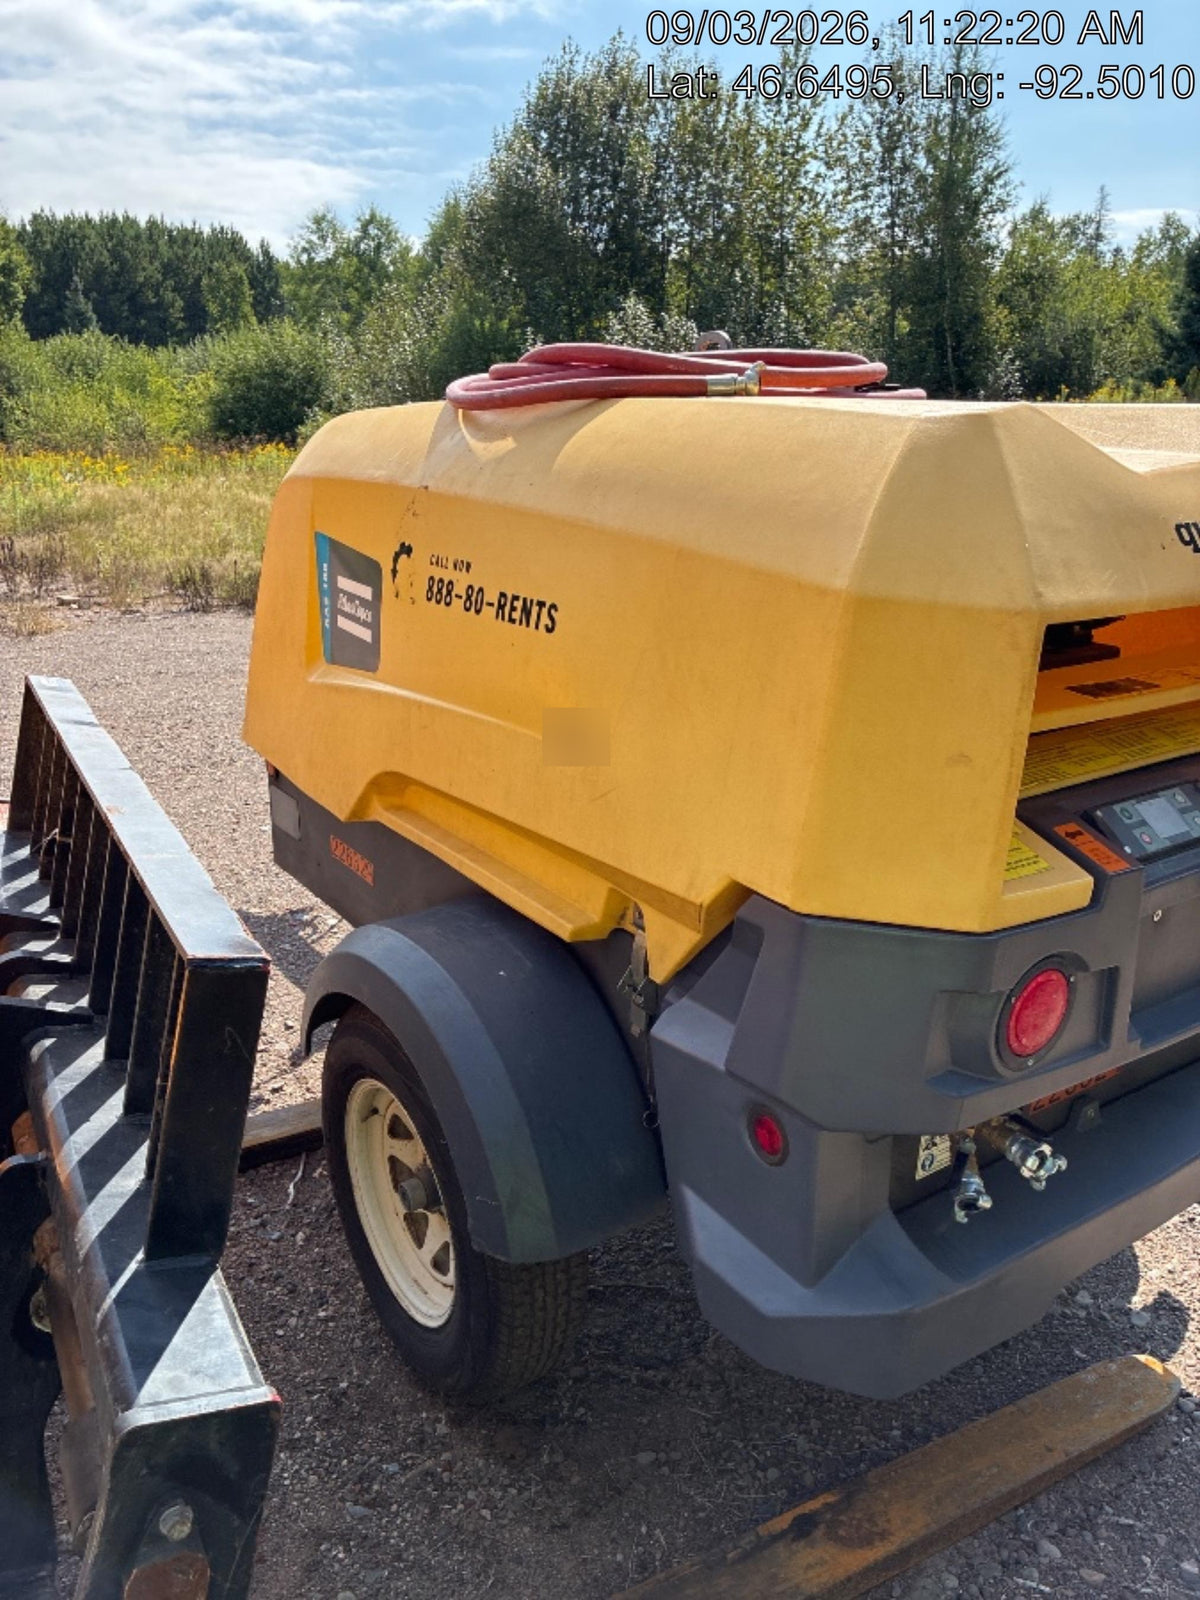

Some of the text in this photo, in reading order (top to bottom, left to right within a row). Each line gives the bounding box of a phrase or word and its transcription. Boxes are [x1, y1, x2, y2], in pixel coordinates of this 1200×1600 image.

[429, 553, 472, 574] CALL NOW
[426, 576, 559, 634] 888-80-RENTS
